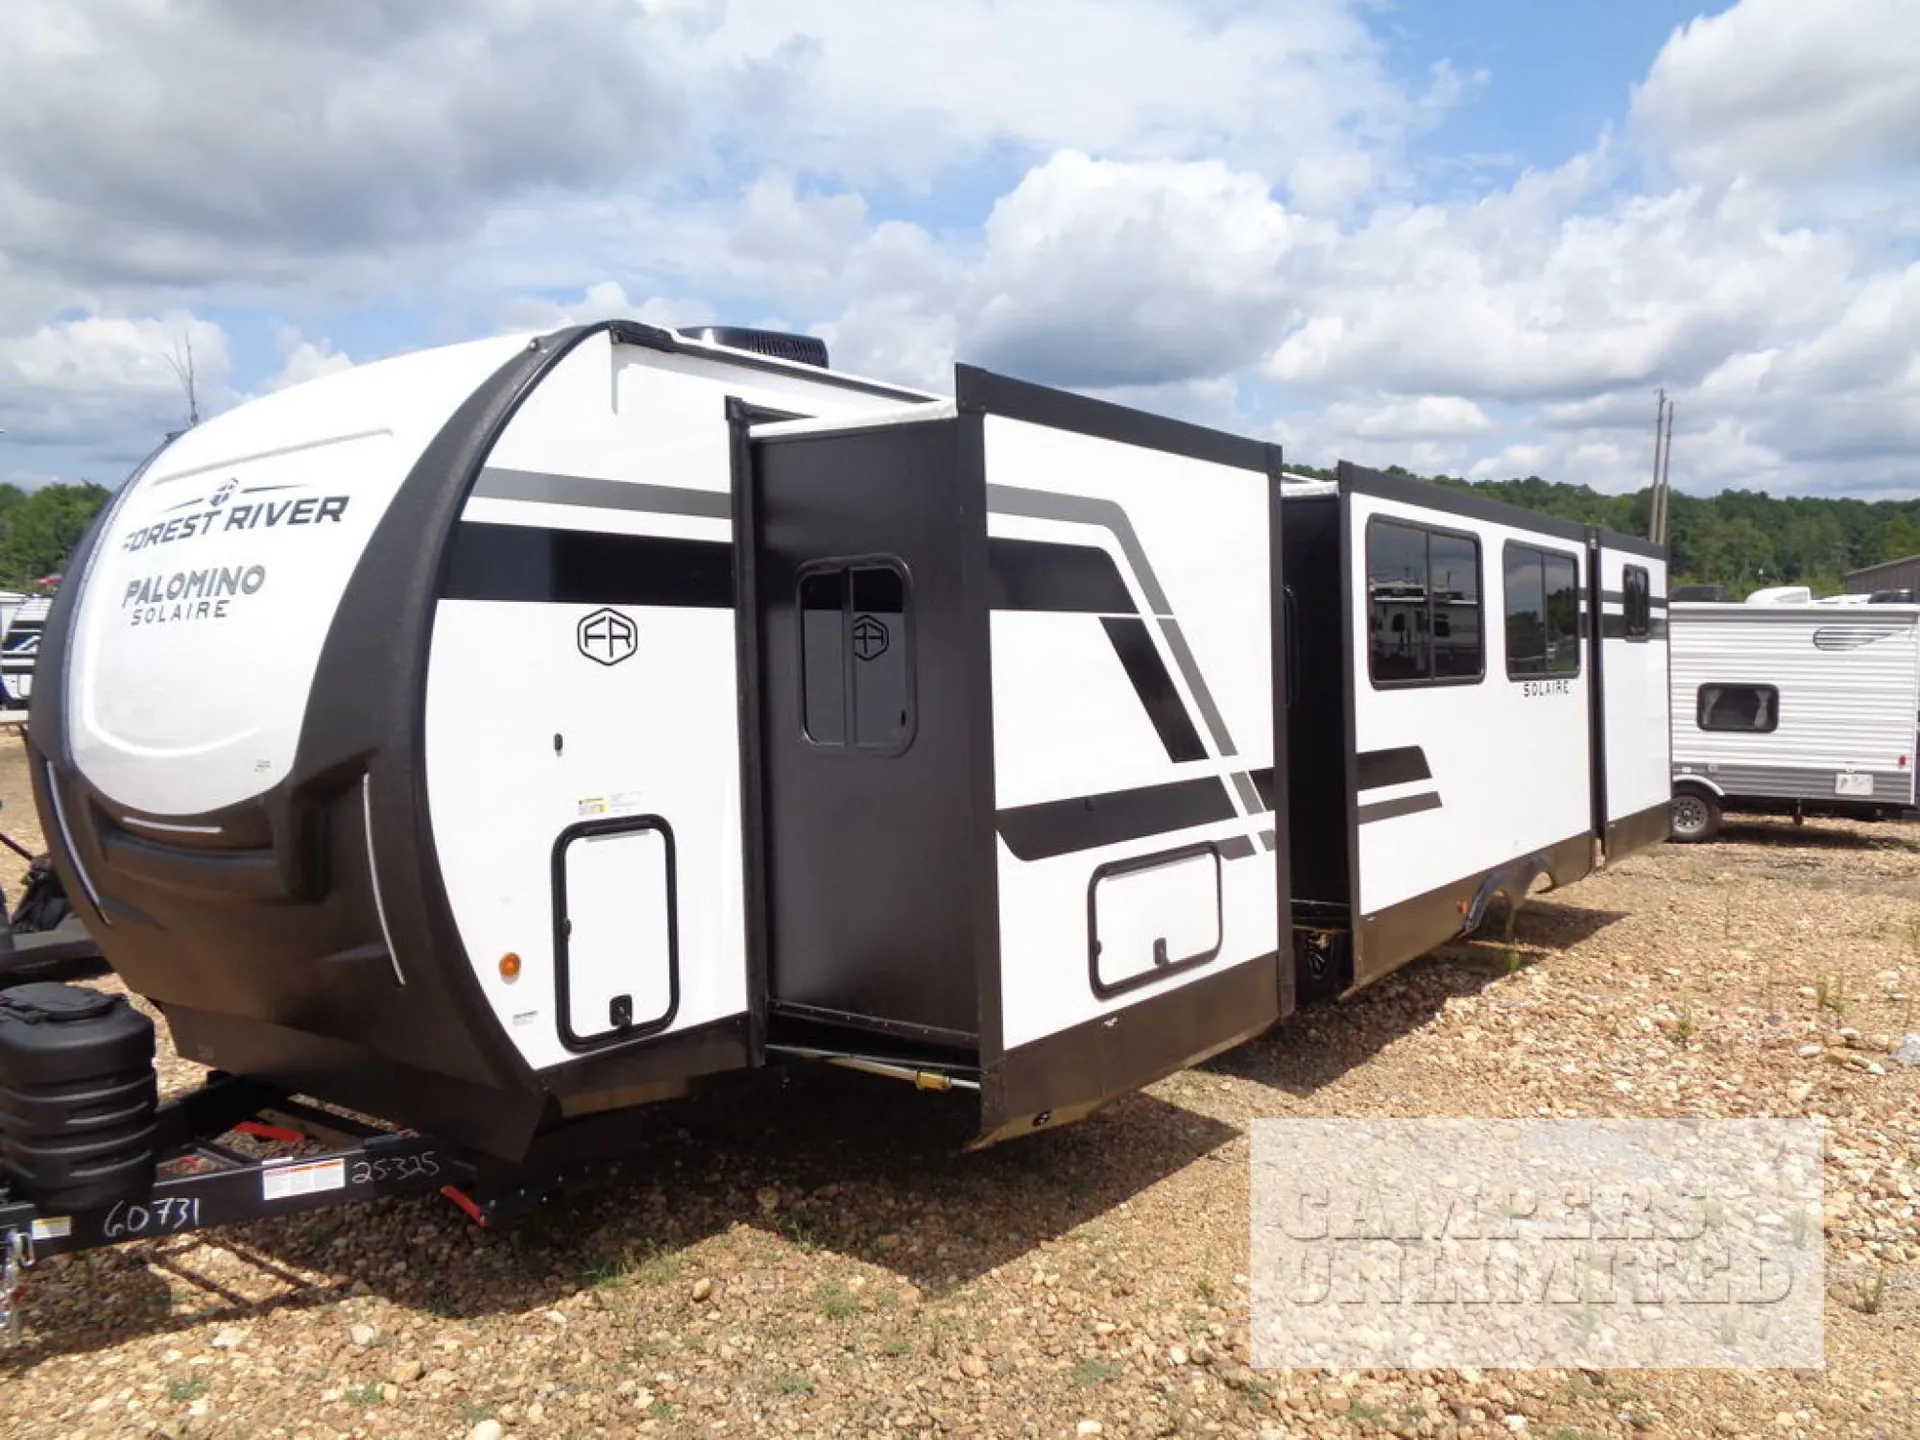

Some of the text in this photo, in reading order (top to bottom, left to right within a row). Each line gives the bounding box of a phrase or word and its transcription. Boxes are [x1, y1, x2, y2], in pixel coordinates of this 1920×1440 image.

[224, 495, 350, 532] RIVER
[122, 565, 266, 609] PALOMINO
[130, 600, 230, 626] SOLAIRE
[1523, 680, 1570, 698] SOLAIRE
[103, 1196, 200, 1238] 60731
